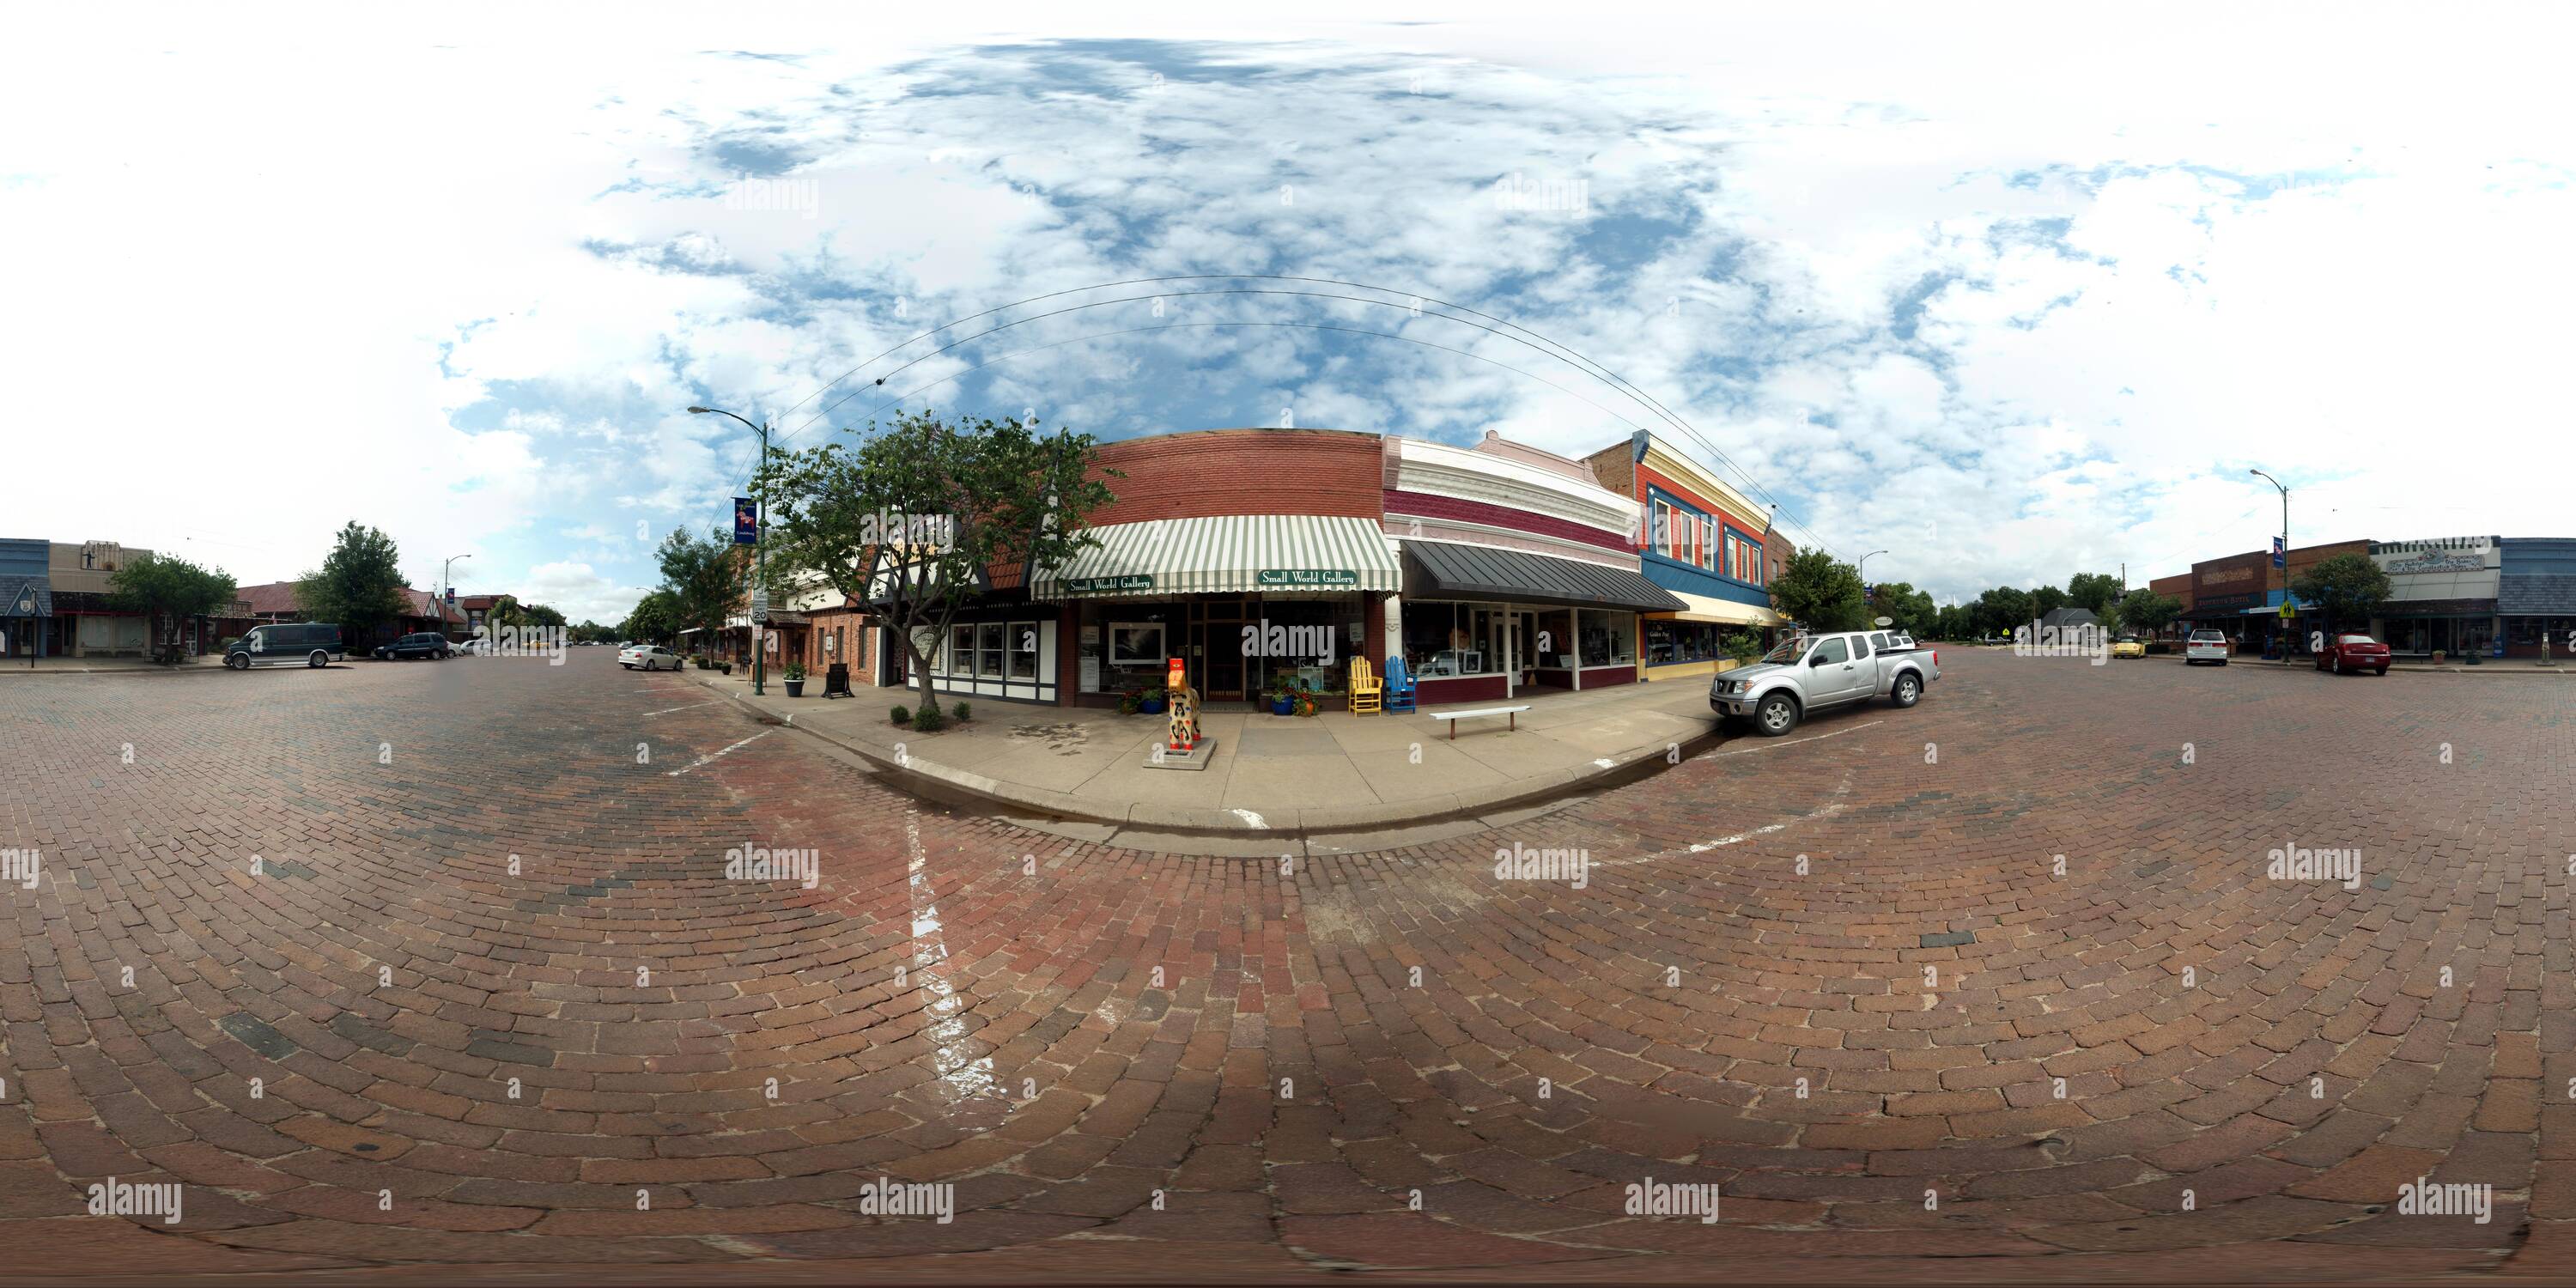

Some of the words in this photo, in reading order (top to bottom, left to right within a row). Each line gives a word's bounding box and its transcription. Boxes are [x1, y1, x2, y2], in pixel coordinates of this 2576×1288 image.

[1070, 580, 1091, 591] Small
[1094, 578, 1117, 590] World
[1121, 576, 1150, 588] Gallery
[1262, 571, 1288, 583] Small
[1291, 571, 1319, 583] World
[1322, 571, 1354, 585] Gallery
